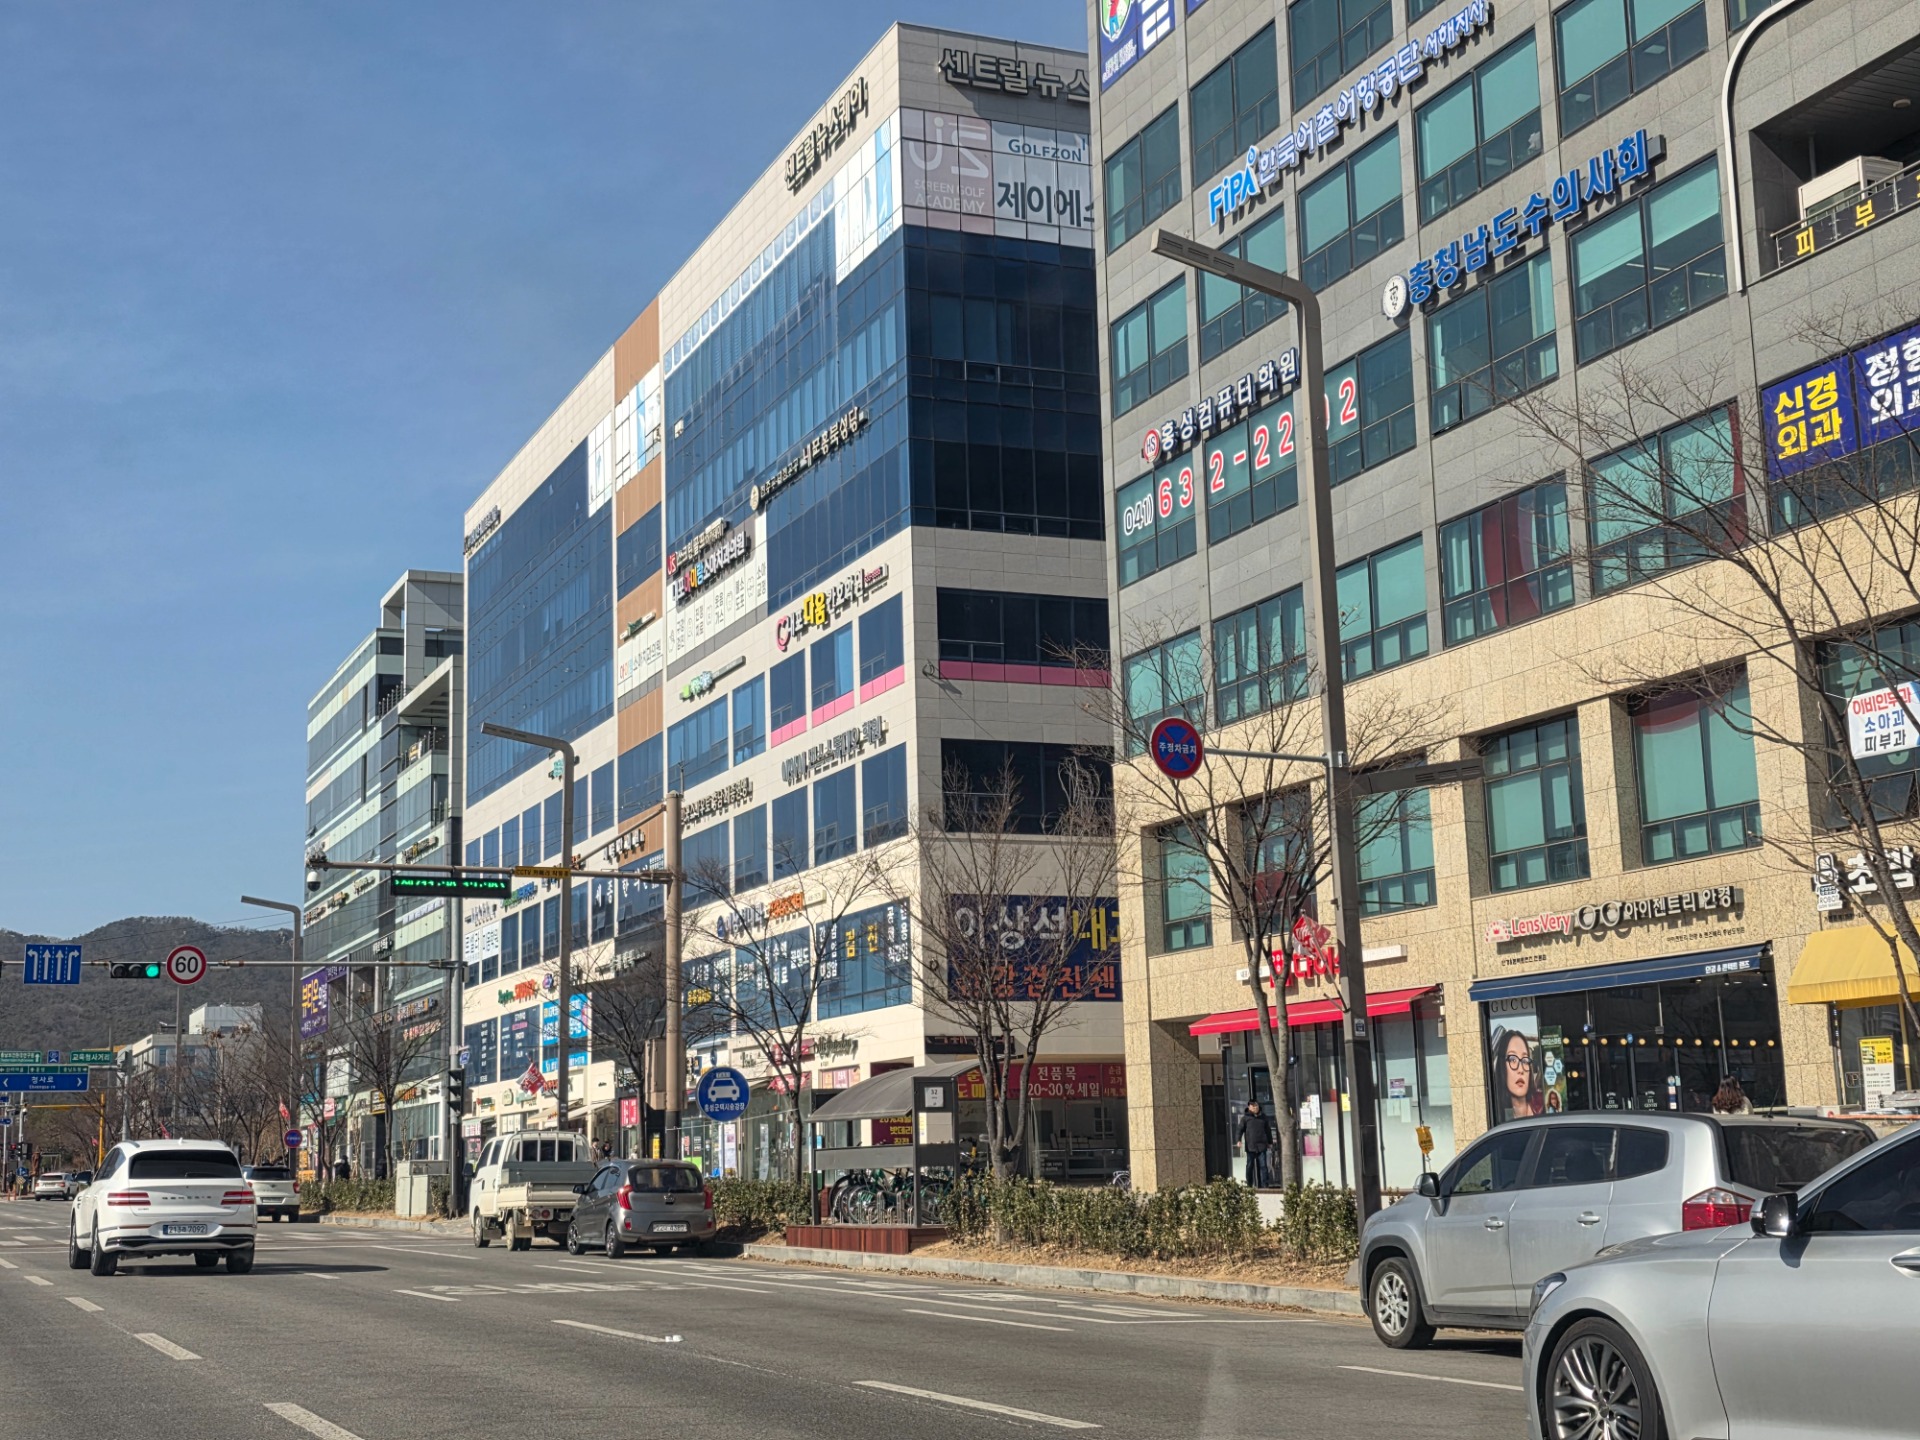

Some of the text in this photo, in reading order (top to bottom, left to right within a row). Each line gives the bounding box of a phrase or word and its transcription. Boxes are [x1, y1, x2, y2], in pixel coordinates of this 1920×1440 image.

[1258, 43, 1421, 188] 한국어촌어항공단
[1423, 0, 1488, 58] 서해지사
[1007, 138, 1083, 163] GOLFZON
[914, 178, 985, 199] SCREEN GOLF
[914, 193, 985, 215] ACADEMY
[996, 180, 1092, 228] 제이에
[1408, 128, 1650, 306] 충청남도수의사회
[1160, 347, 1300, 451] 홍성컴퓨터학원
[1773, 371, 1839, 426] 신경
[1776, 406, 1843, 460] 외과
[1864, 709, 1906, 734] 소아과
[1158, 741, 1197, 755] 주정차금지
[1864, 729, 1907, 752] 피부과
[1510, 885, 1734, 937] LensVery 아이젠트리 안경
[175, 956, 199, 974] 60
[1490, 996, 1535, 1014] GUCCI
[71, 1052, 111, 1062] 교육청사거리
[31, 1076, 54, 1085] 청사로
[1037, 1065, 1077, 1082] 전품목
[930, 1088, 938, 1096] 32
[1027, 1081, 1100, 1098] 20~30% 세일
[704, 1102, 745, 1113] 홍성군택시승강장
